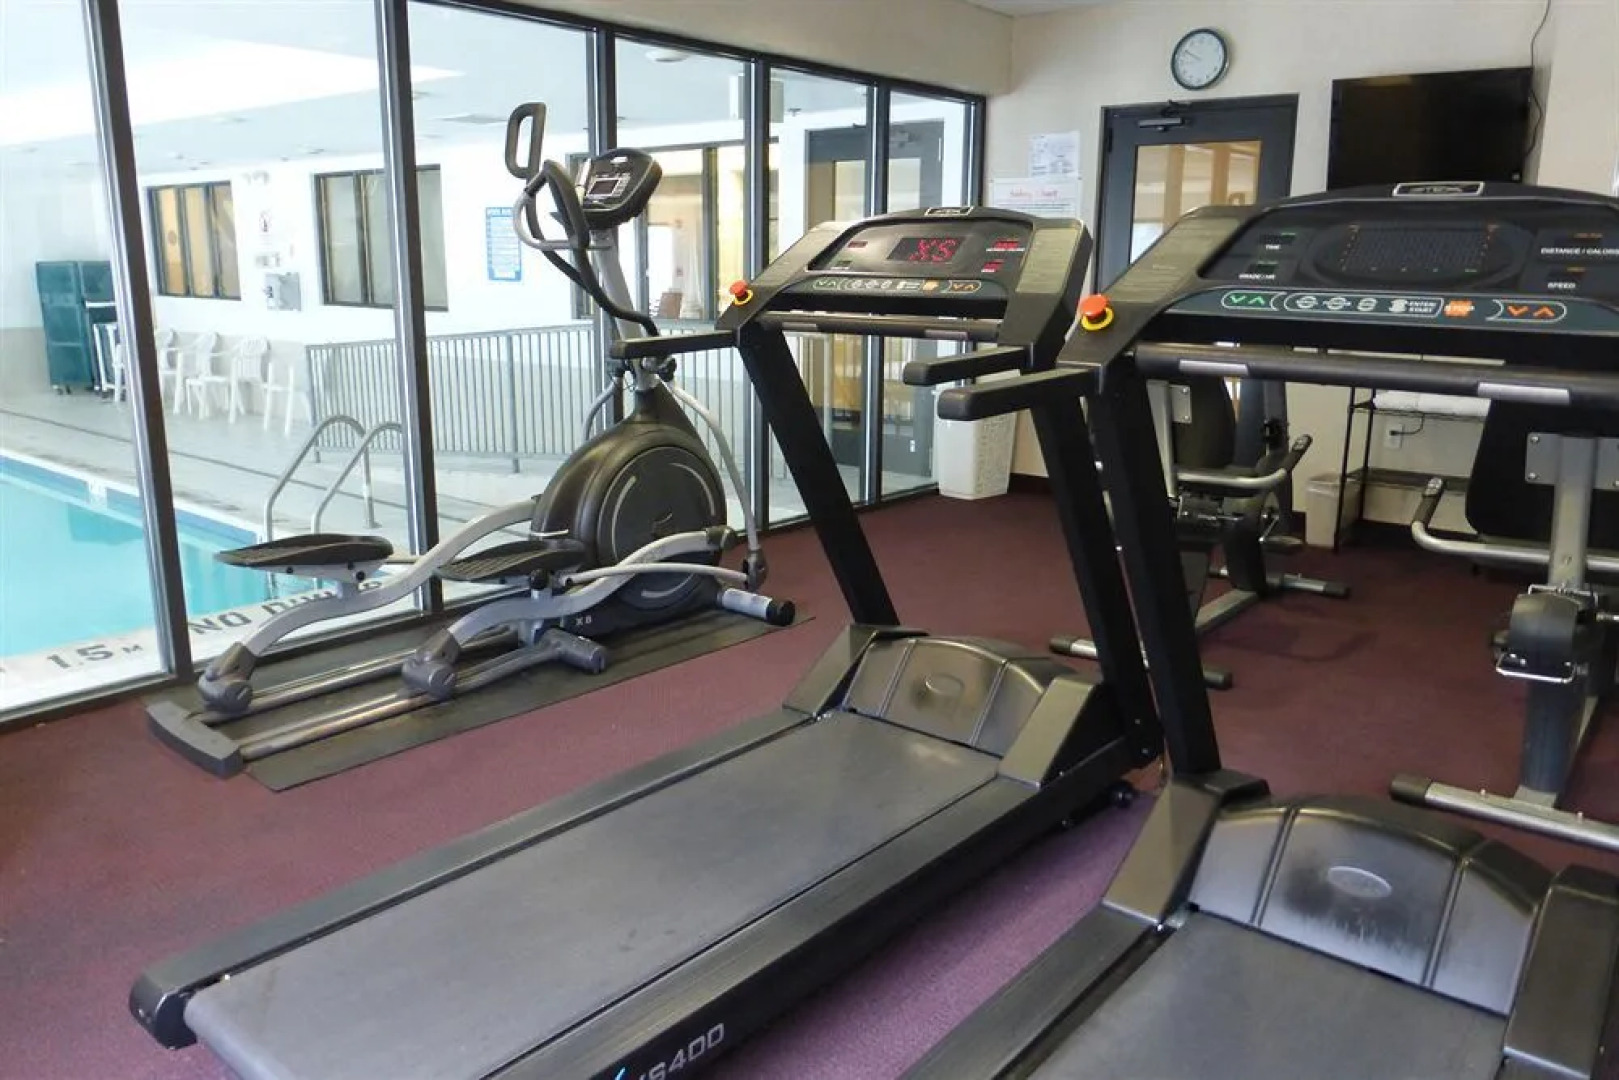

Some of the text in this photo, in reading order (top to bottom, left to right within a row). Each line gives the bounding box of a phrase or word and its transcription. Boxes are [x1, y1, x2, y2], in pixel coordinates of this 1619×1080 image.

[1540, 247, 1581, 255] DISTANCE
[1547, 281, 1577, 289] SPEED
[188, 610, 252, 635] NO
[638, 1022, 725, 1080] S400
